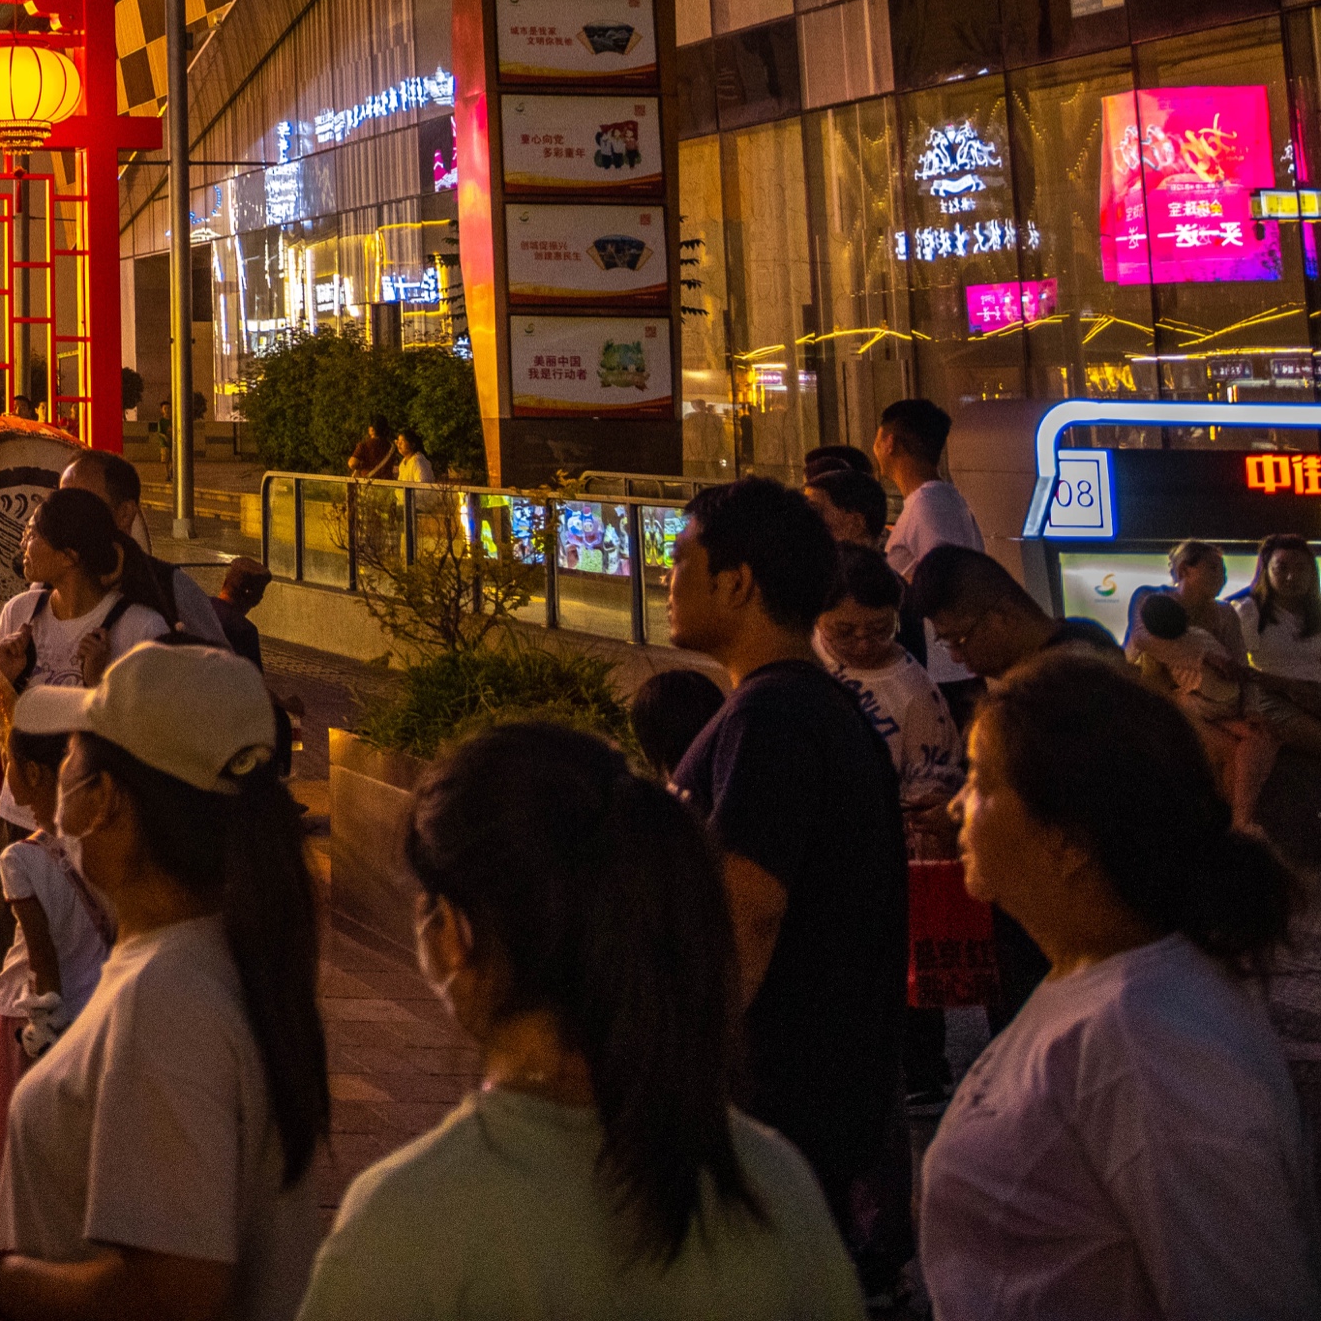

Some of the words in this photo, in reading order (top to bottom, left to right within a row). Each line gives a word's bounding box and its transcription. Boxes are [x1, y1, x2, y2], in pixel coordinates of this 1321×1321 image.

[510, 26, 557, 36] 城市是我家
[527, 36, 573, 47] 文明你我他
[520, 134, 564, 145] 童心向党
[543, 147, 586, 159] 多彩童年
[533, 355, 582, 368] 美丽中国
[528, 368, 588, 381] 我是行动者
[1055, 479, 1095, 509] 08
